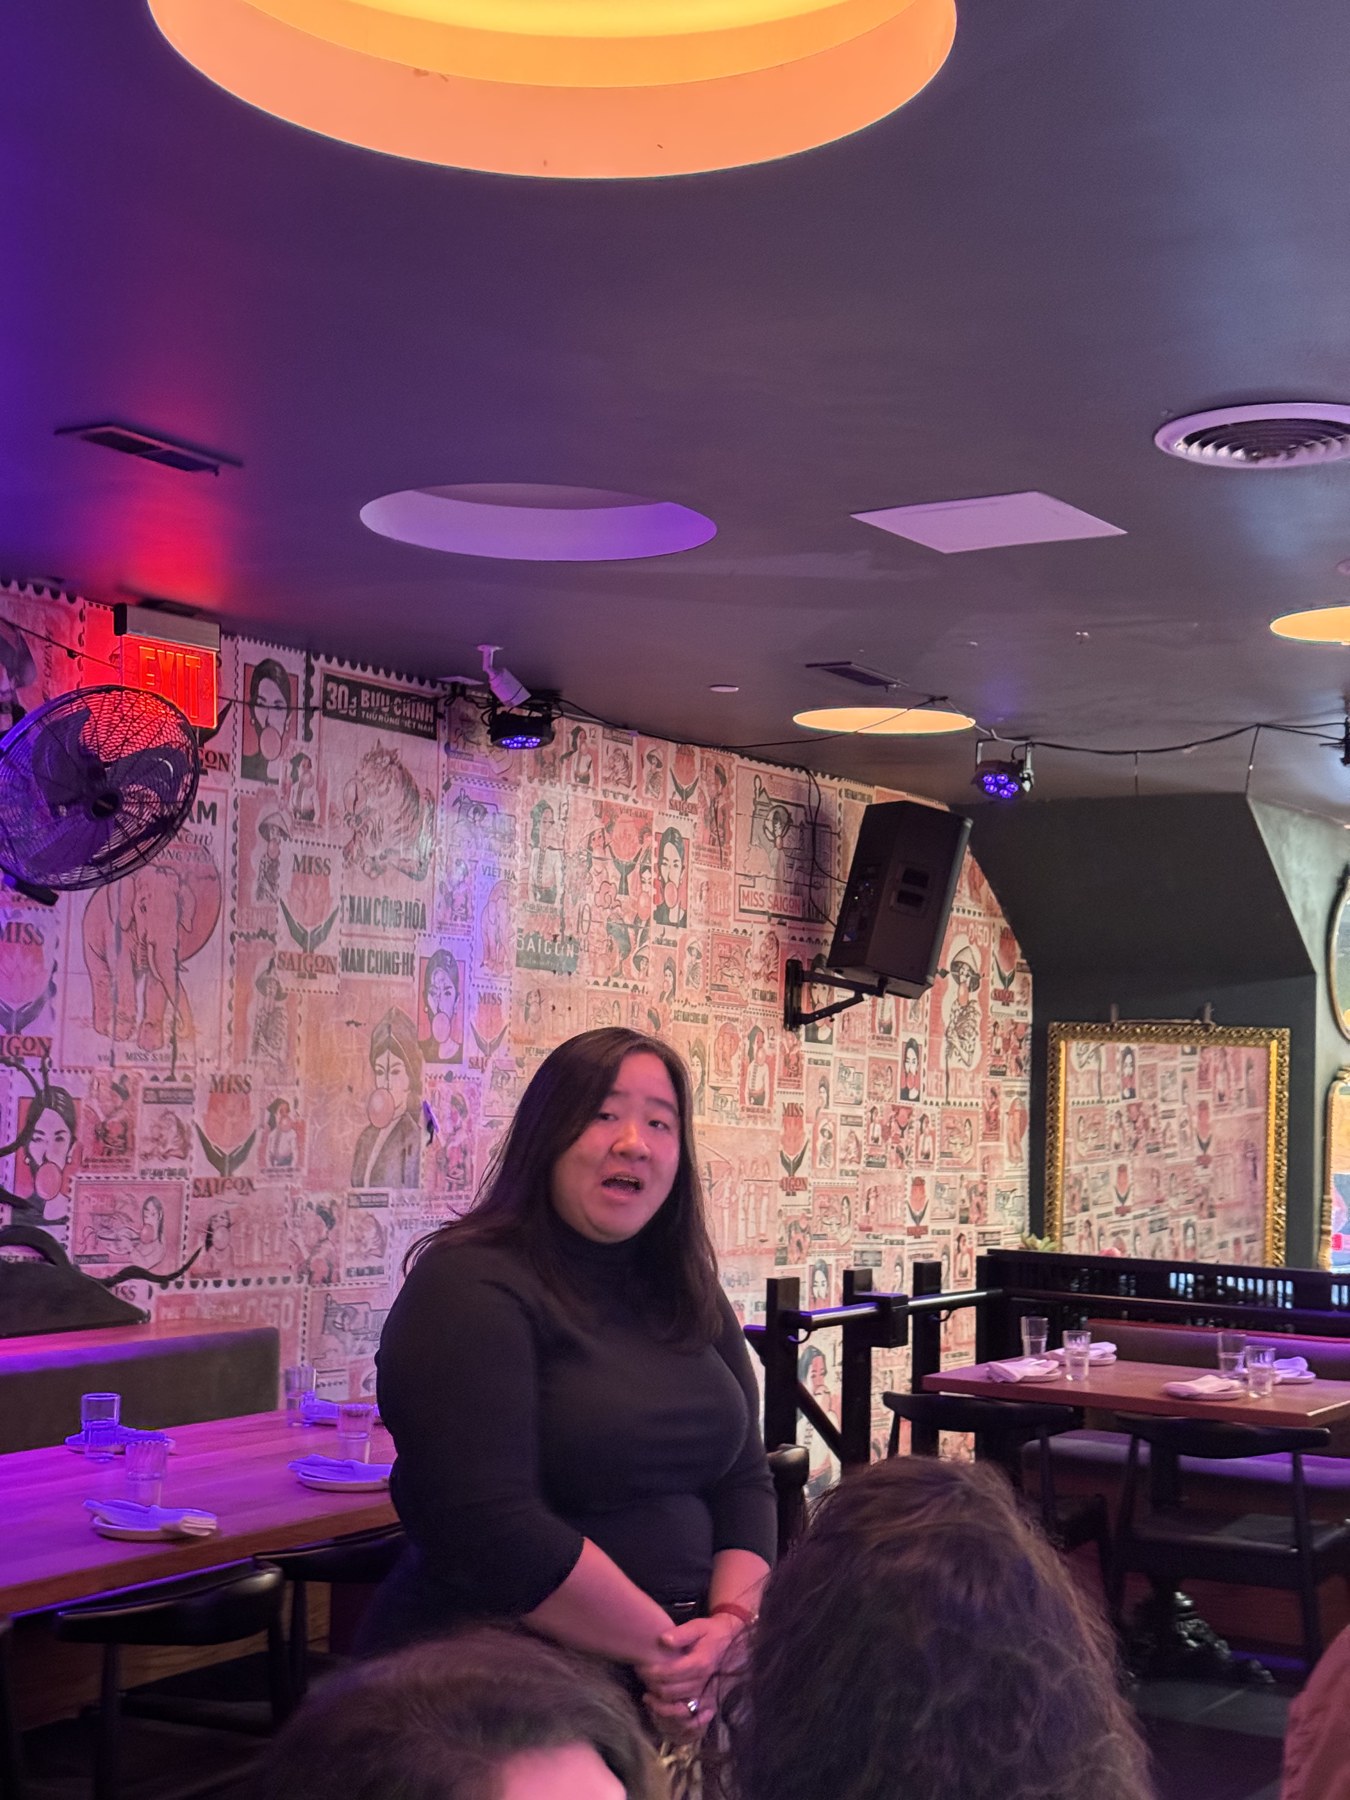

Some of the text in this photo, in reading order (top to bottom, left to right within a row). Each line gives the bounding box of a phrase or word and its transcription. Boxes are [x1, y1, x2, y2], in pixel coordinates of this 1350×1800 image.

[139, 646, 200, 718] EXIT
[291, 853, 332, 877] MISS
[741, 889, 801, 914] MISS SAIGON
[276, 950, 338, 975] SAIGON
[477, 991, 502, 1006] MISS
[209, 1073, 253, 1094] MISS
